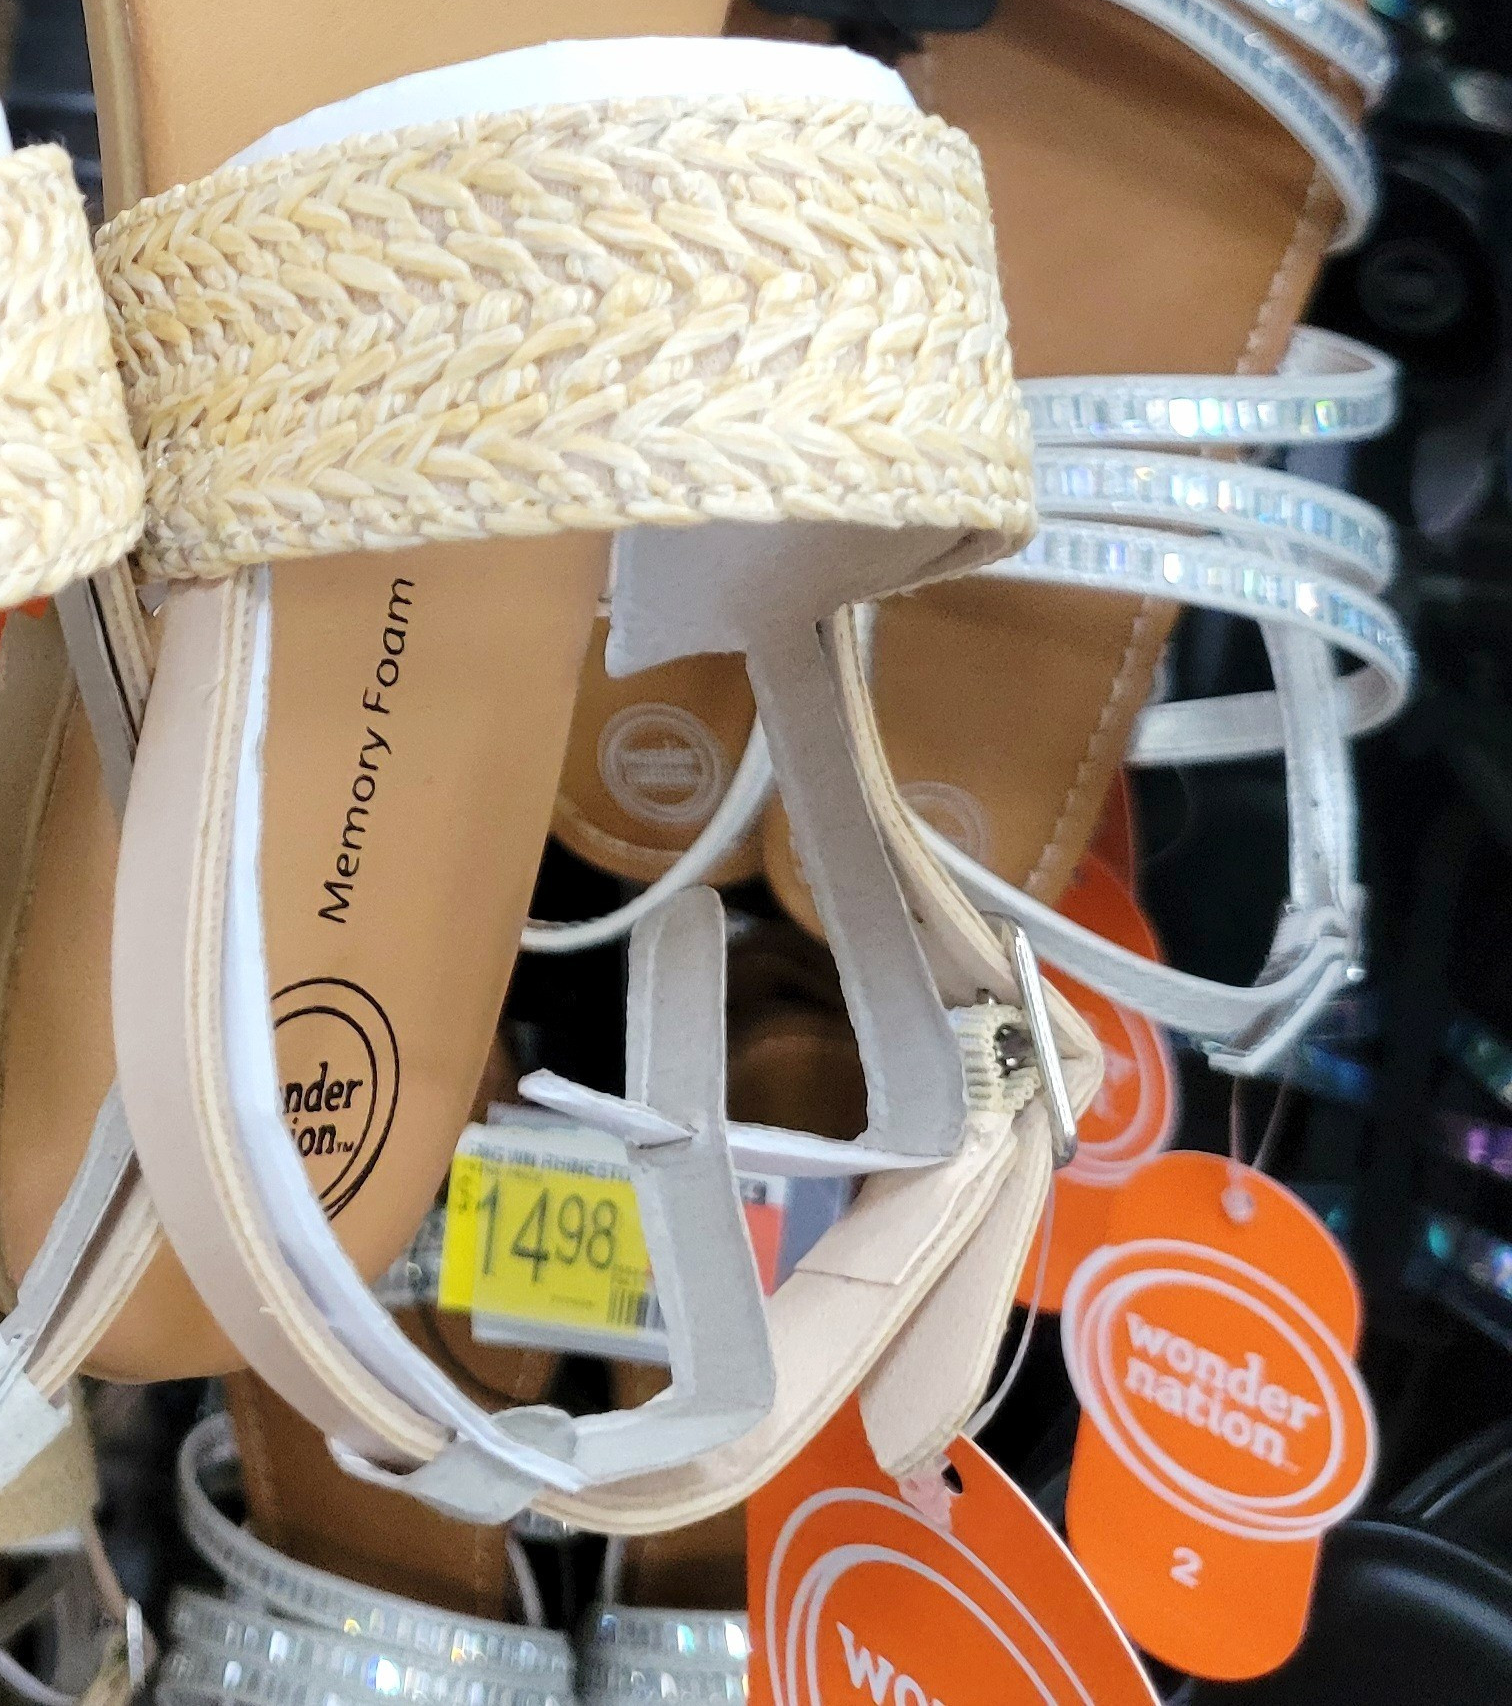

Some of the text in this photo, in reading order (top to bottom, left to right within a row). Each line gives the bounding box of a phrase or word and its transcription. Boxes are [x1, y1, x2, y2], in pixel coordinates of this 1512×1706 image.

[317, 578, 416, 924] Memory Foam
[279, 1060, 364, 1114] nder
[1125, 1311, 1322, 1432] wonder
[1169, 1546, 1203, 1589] 2
[836, 1620, 946, 1706] wo
